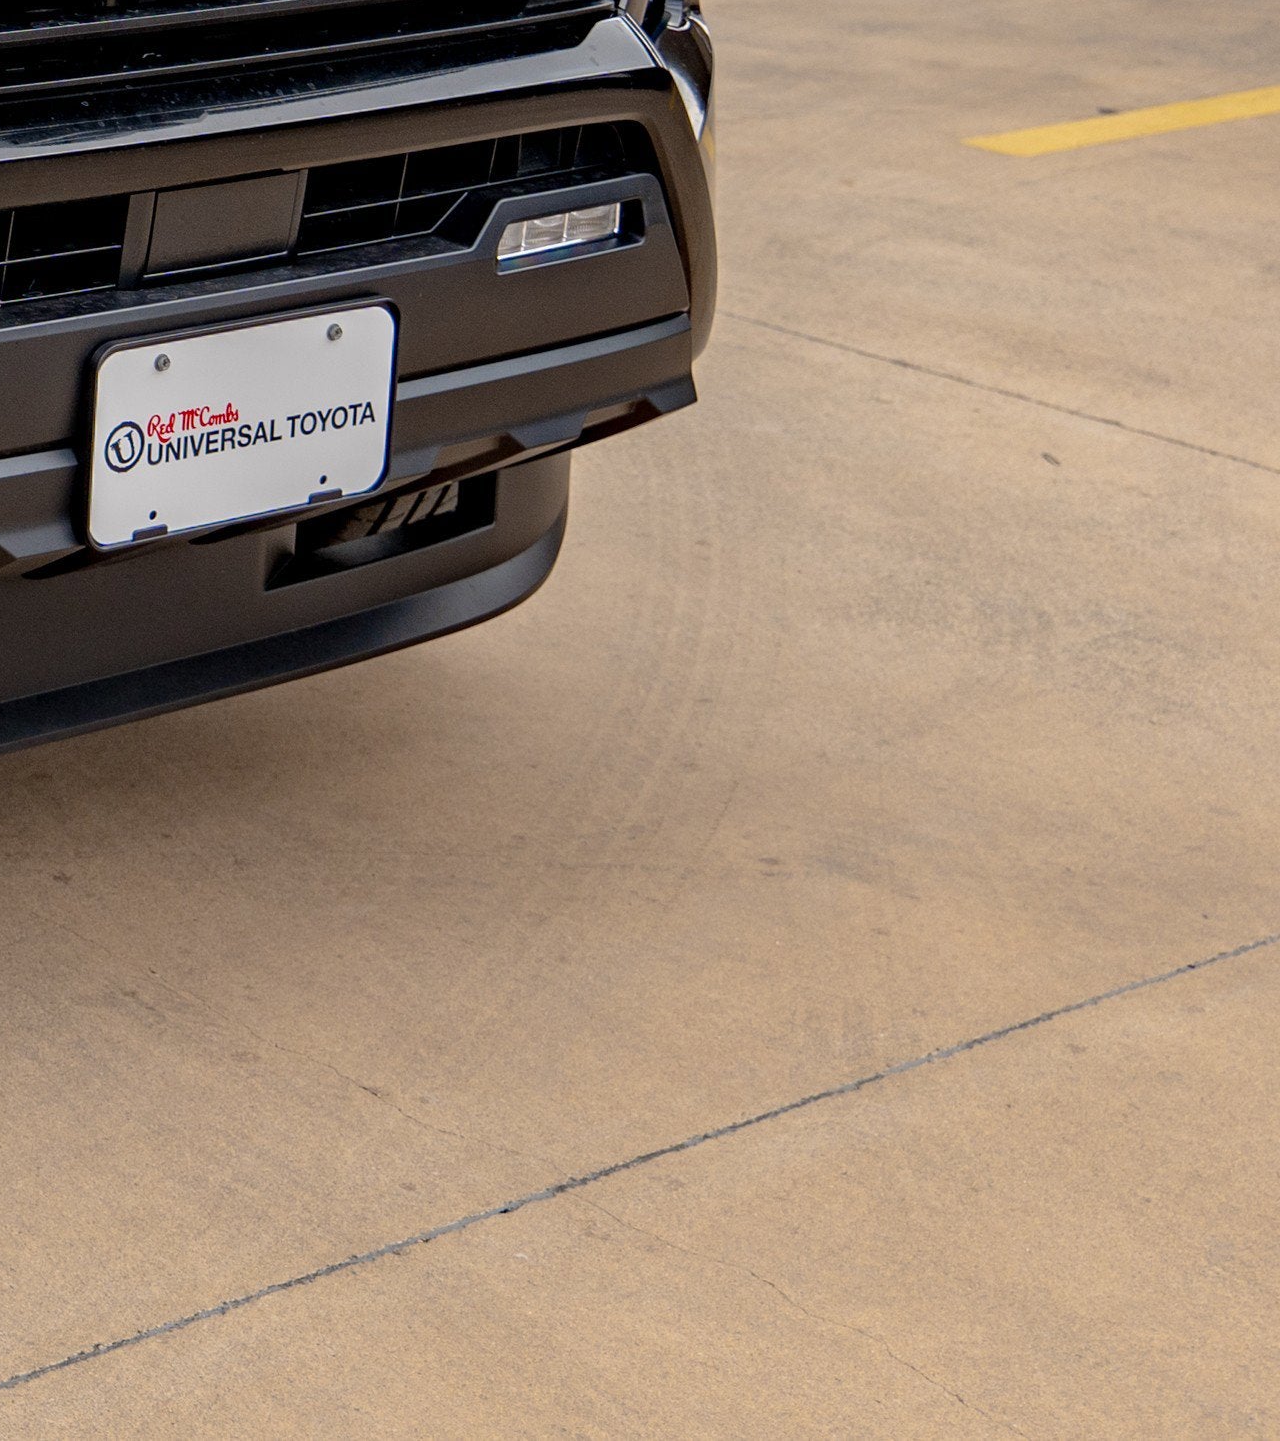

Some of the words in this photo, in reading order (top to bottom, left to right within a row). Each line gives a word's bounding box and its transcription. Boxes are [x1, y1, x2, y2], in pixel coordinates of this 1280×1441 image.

[147, 414, 175, 442] Red
[178, 402, 239, 432] McCombs
[147, 419, 283, 465] UNIVERSAL
[286, 401, 377, 438] TOYOTA
